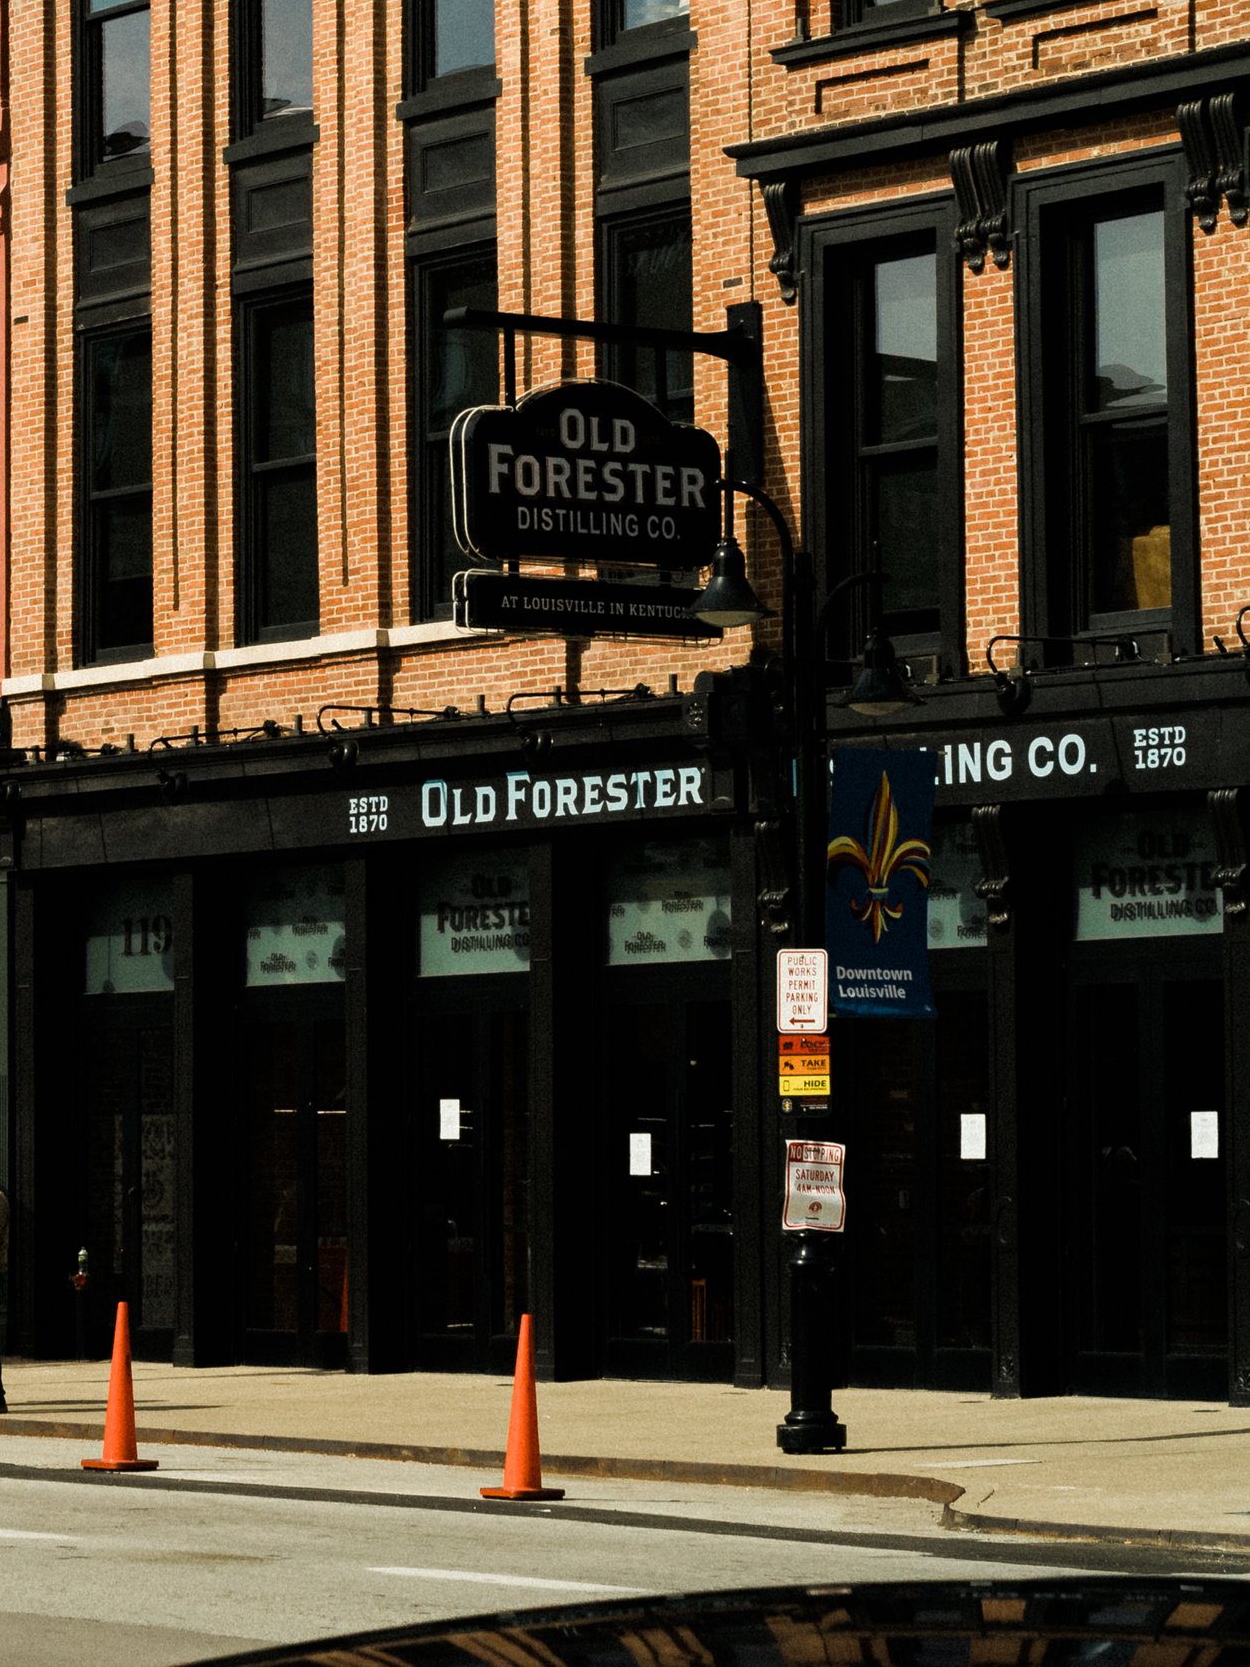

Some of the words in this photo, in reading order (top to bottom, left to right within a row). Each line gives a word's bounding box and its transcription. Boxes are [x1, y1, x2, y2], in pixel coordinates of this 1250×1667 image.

[559, 407, 636, 454] OLD
[487, 443, 707, 509] FORESTER
[517, 506, 639, 538] DISTILLING
[646, 515, 681, 540] CO.
[501, 595, 519, 609] AT
[523, 596, 606, 615] LOUISVILLE
[609, 602, 625, 616] IN
[629, 603, 690, 620] KENTUC
[1134, 725, 1186, 748] ESTD
[1027, 733, 1098, 778] CO.
[1134, 746, 1187, 770] 1870
[349, 794, 389, 815] ESTD
[421, 777, 497, 828] OLD
[504, 767, 704, 822] FORESTER
[349, 814, 389, 834] 1870
[1138, 830, 1190, 860] OLD
[471, 874, 512, 899] OLD
[1110, 899, 1193, 921] DISTILLING
[118, 915, 173, 957] 119
[451, 933, 513, 953] DISTILLING
[787, 956, 818, 966] PUBLIC
[787, 967, 817, 977] WORKS
[836, 965, 913, 981] Downtown
[788, 980, 816, 990] PERMIT
[838, 984, 907, 999] Louisville
[785, 992, 819, 1003] PARKING
[792, 1004, 812, 1015] ONLY
[801, 1059, 827, 1067] TAKE
[790, 1145, 803, 1160] NO
[795, 1168, 835, 1183] SATURDAY
[796, 1183, 836, 1195] 4AM-NOON
